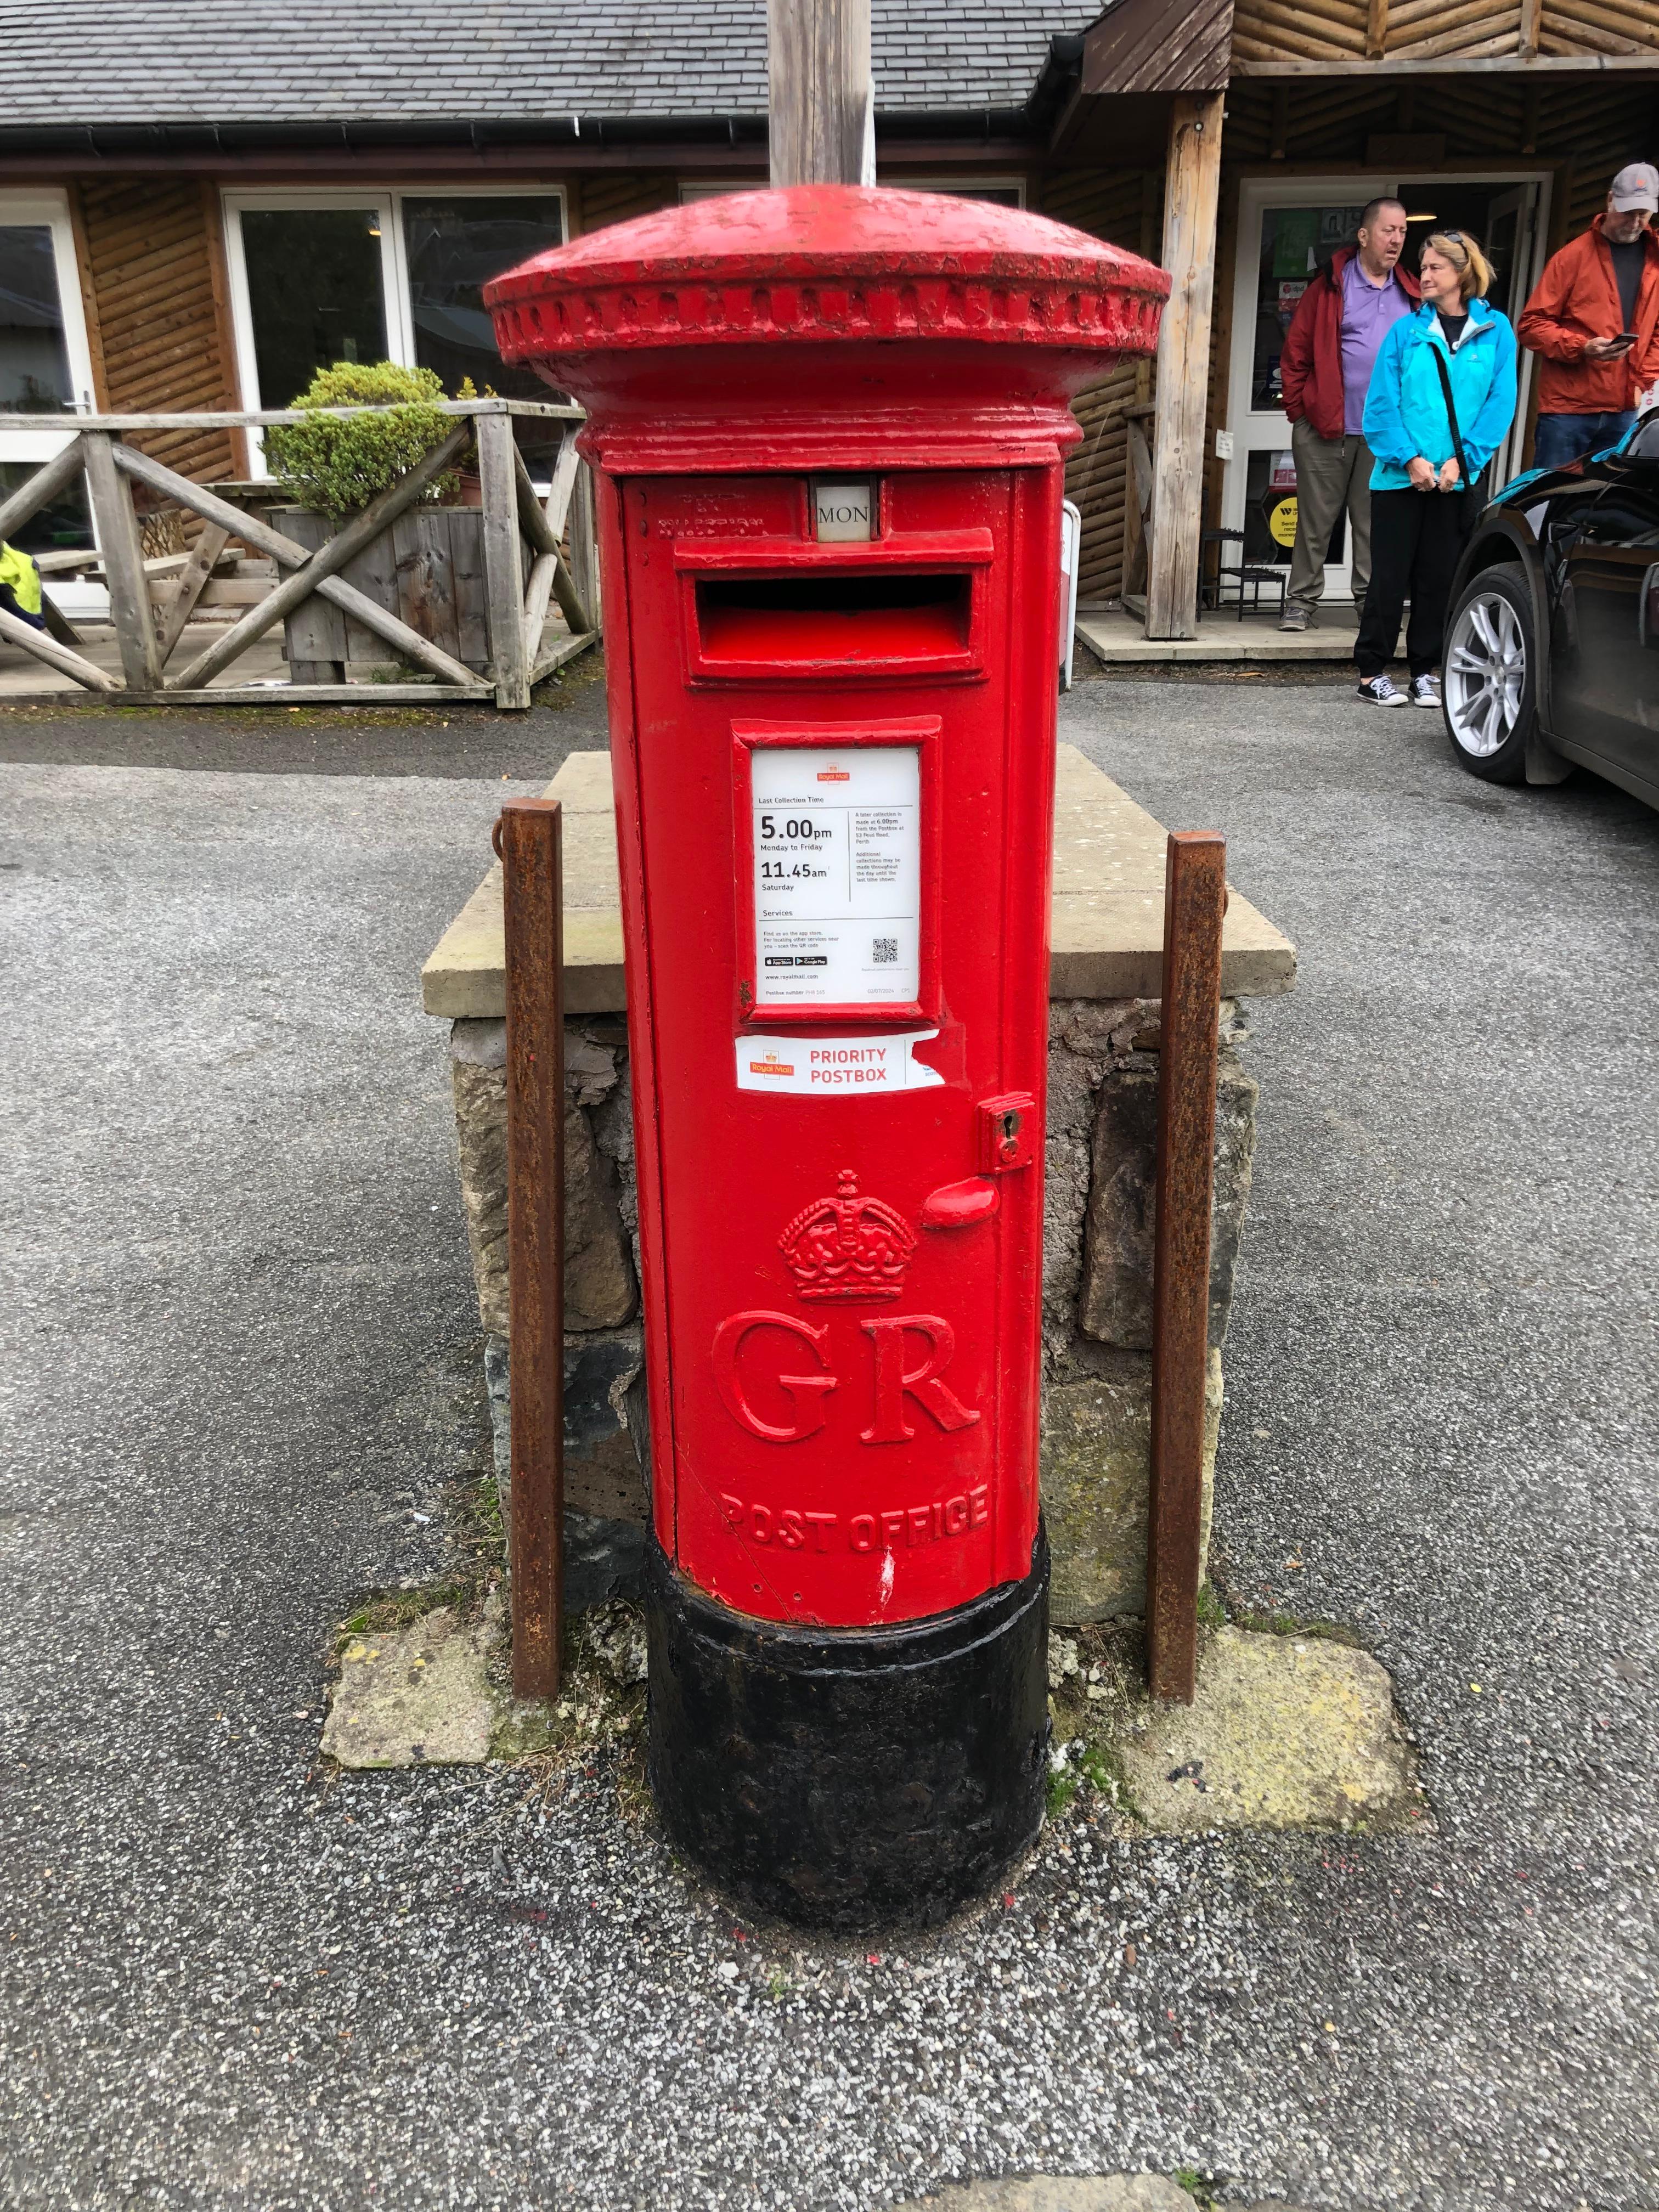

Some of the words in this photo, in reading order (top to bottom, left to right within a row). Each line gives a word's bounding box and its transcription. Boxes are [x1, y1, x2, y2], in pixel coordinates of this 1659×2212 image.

[818, 506, 869, 523] MON
[761, 816, 832, 840] 5.00pm
[761, 861, 827, 878] 11.45am
[762, 884, 794, 892] Saturday
[810, 1048, 887, 1064] PRIORITY
[752, 1063, 773, 1073] Royal
[811, 1068, 887, 1084] POSTBOX
[713, 1310, 981, 1446] GR
[720, 1491, 837, 1553] POST
[849, 1483, 989, 1553] OFFICE
